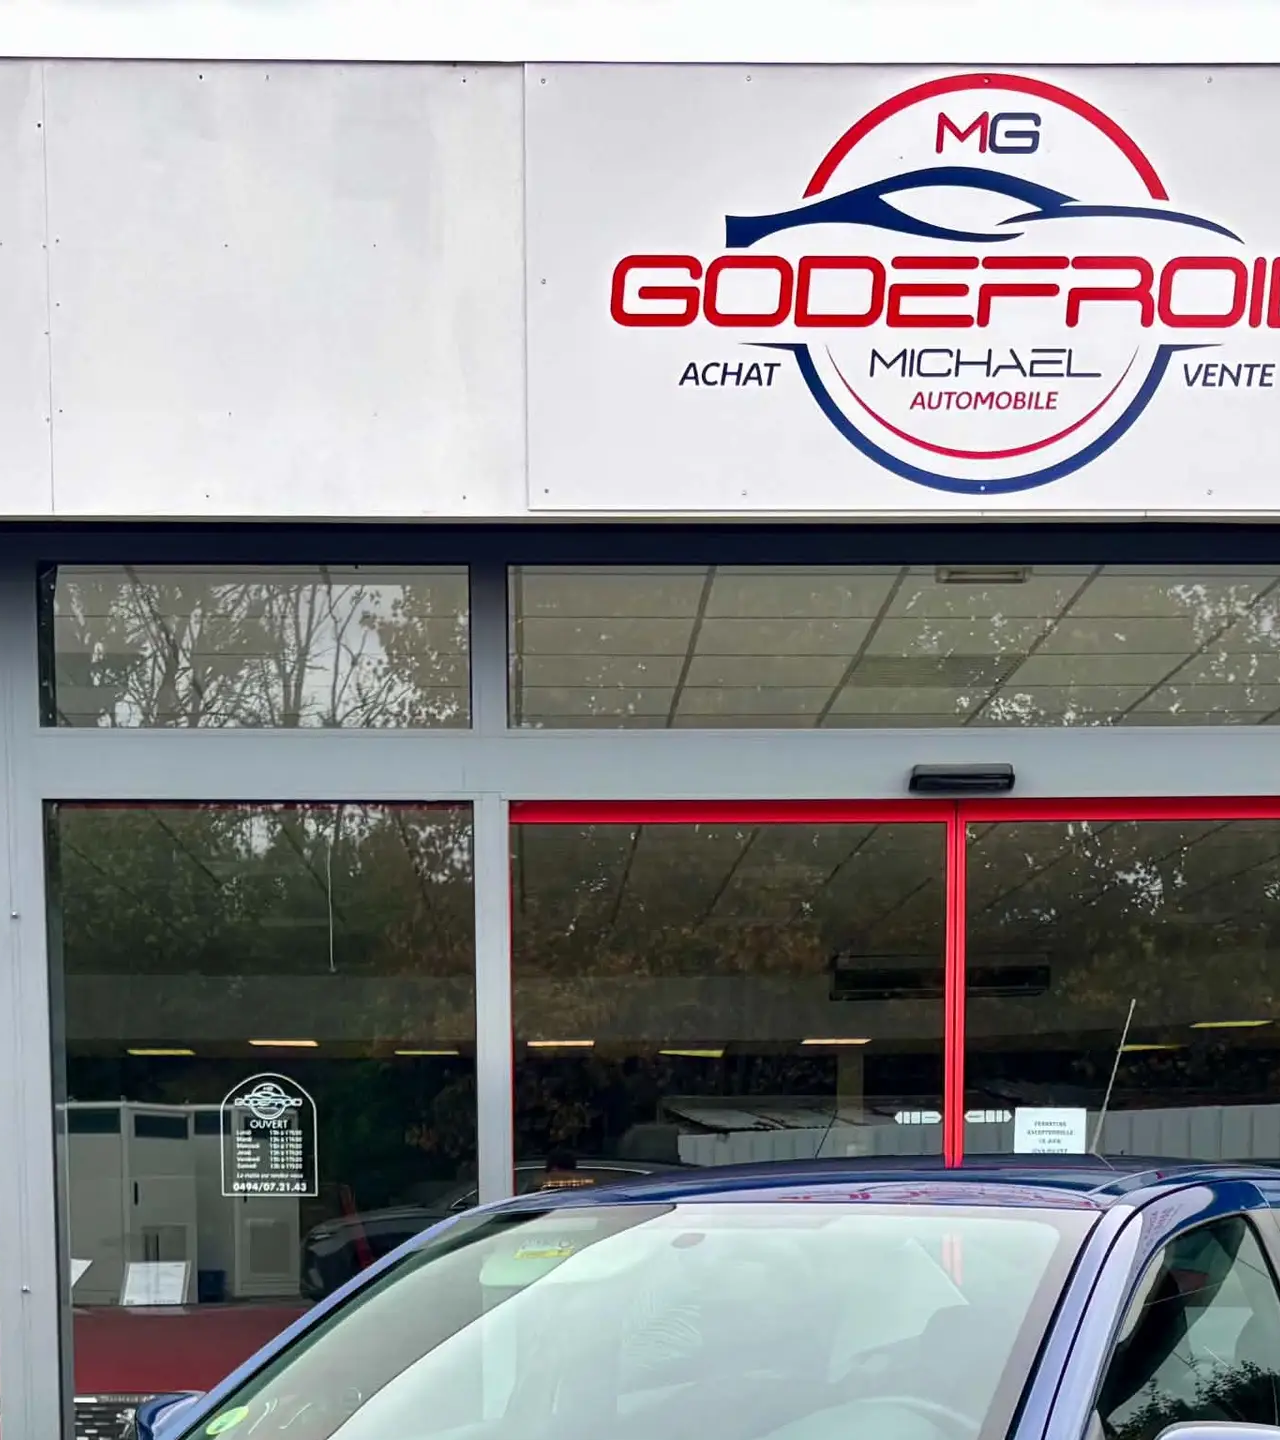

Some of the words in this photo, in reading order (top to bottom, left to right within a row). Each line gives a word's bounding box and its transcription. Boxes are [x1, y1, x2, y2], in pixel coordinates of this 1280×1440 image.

[935, 111, 1042, 155] MG
[679, 362, 782, 387] ACHAT
[869, 348, 1103, 378] MICHAEL
[1183, 362, 1277, 388] VENTE
[909, 391, 1060, 411] AUTOMOBILE
[249, 1119, 289, 1129] OUVERT
[232, 1182, 308, 1192] 0494/07.21.43
